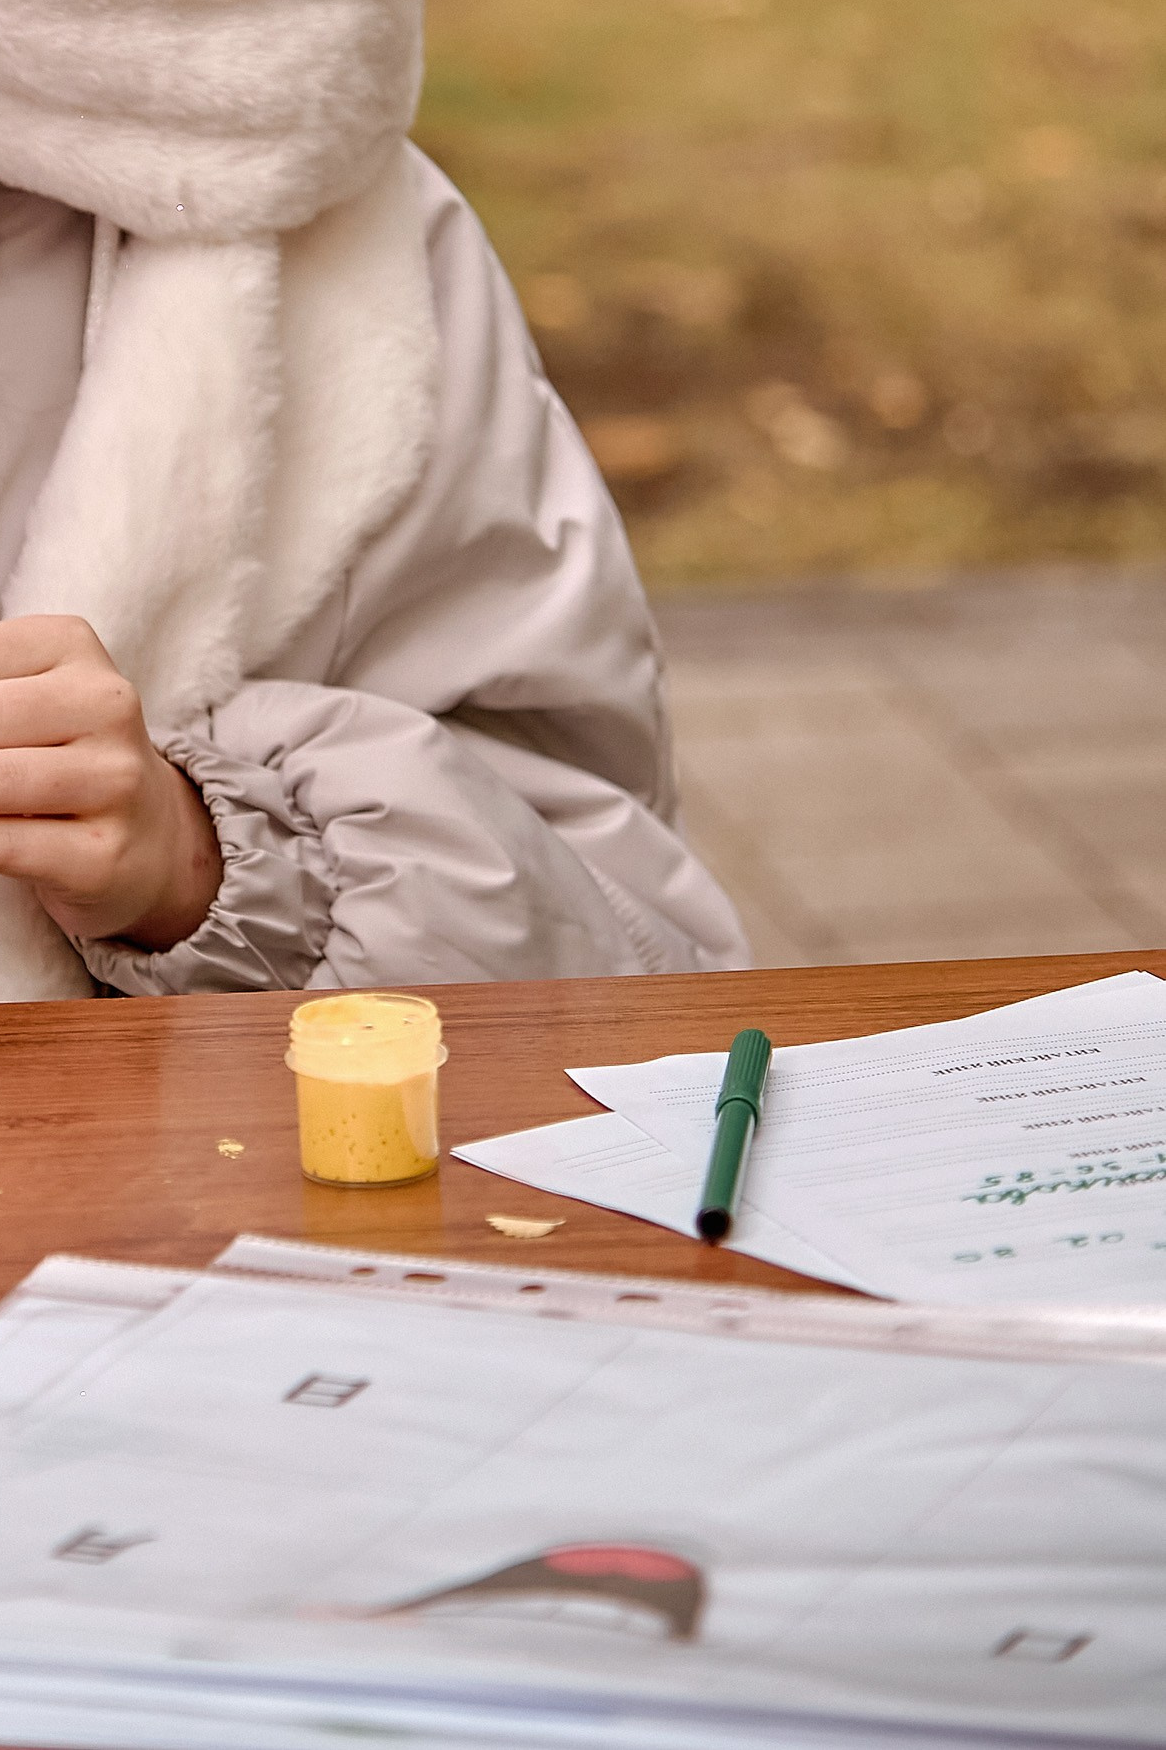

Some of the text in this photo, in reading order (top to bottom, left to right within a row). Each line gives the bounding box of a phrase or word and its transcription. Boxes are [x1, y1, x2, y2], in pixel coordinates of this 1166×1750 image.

[931, 1047, 1102, 1078] КИТАЙСКИЙ ЯЗЫК
[975, 1076, 1147, 1104] КИТАЙСКИЙ ЯЗЫК
